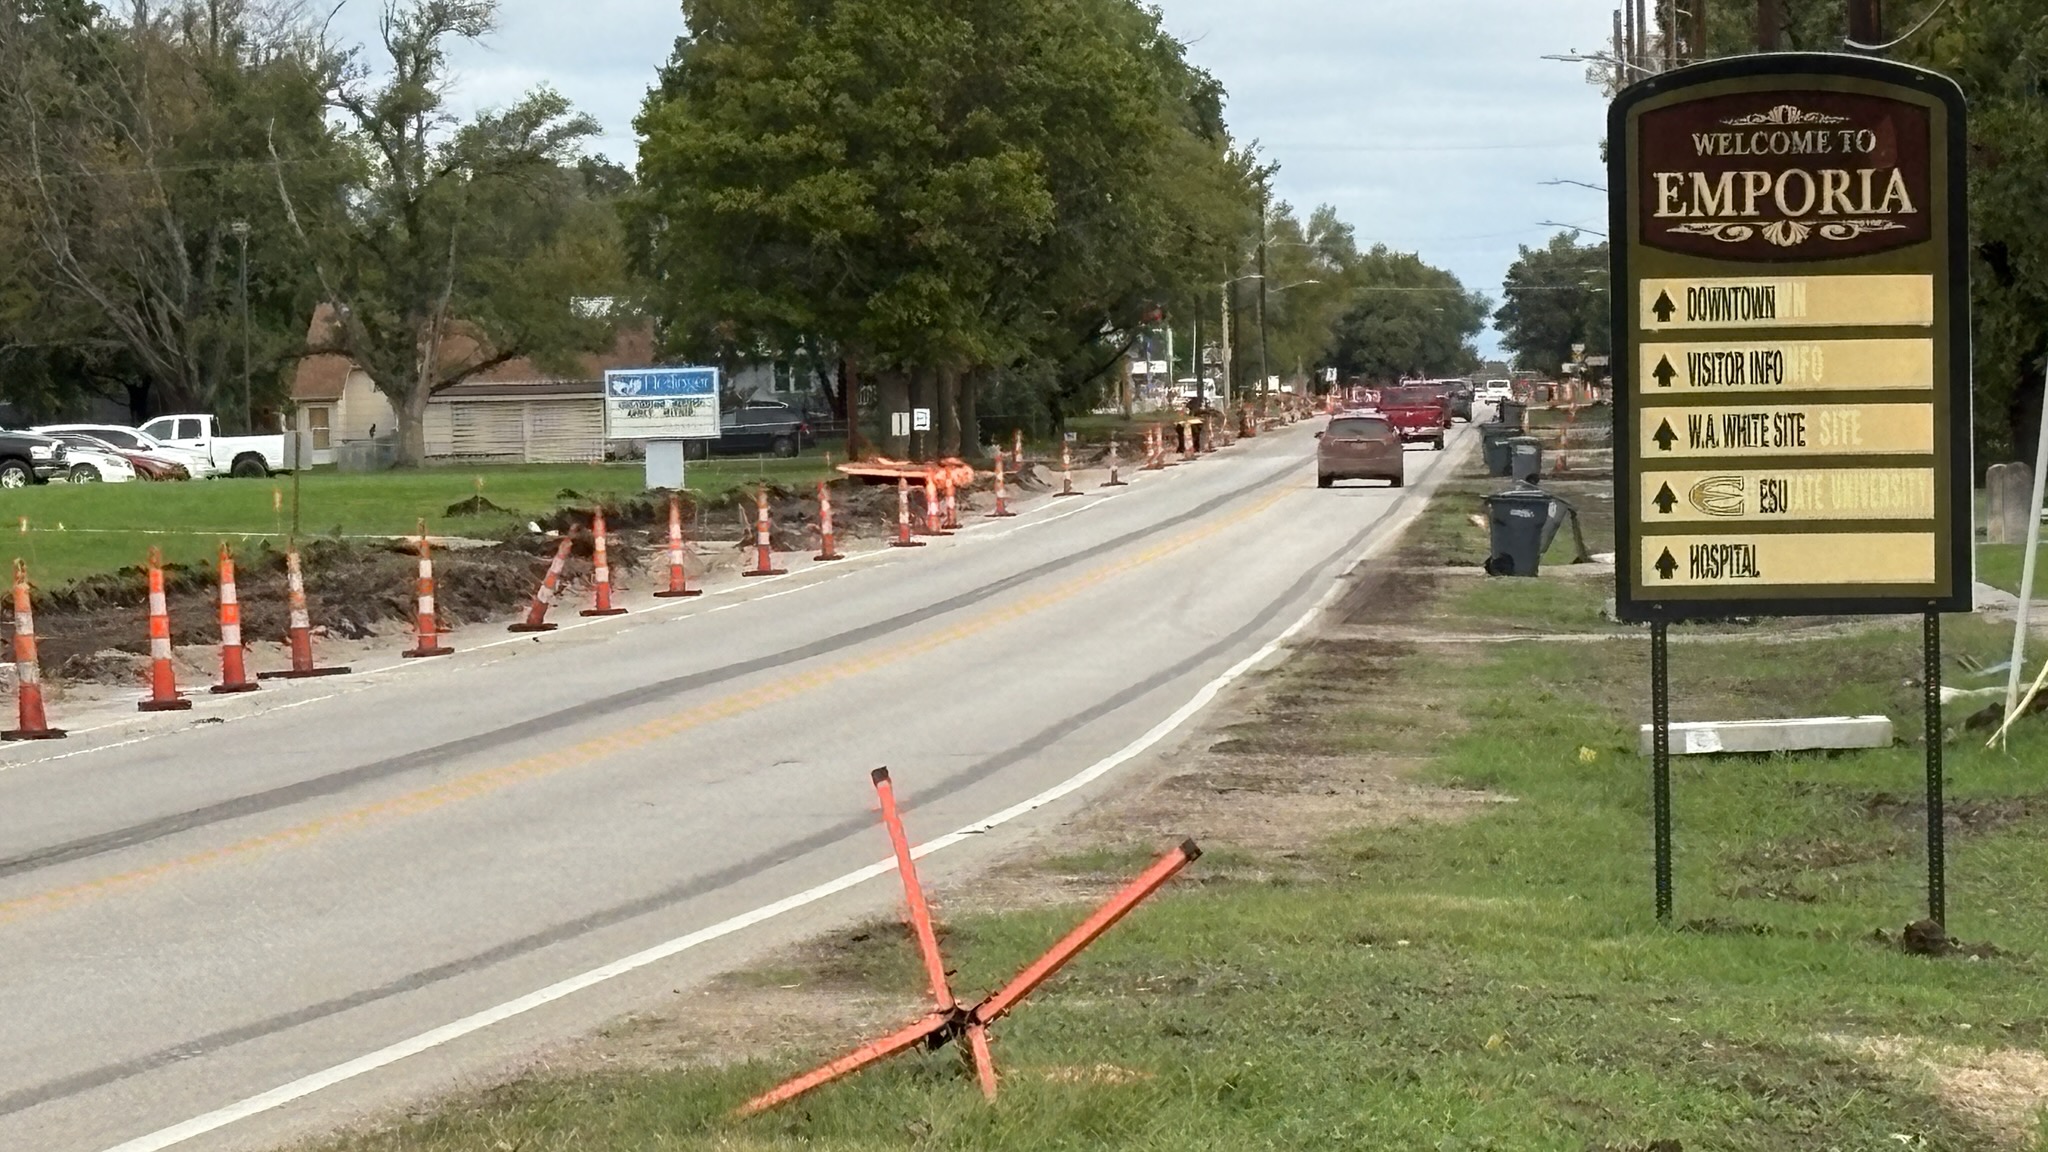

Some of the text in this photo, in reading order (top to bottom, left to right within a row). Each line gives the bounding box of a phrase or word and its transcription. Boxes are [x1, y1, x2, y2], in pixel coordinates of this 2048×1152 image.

[1692, 129, 1876, 156] WELCOME TO
[1653, 167, 1918, 218] EMPORIA
[1687, 285, 1776, 321] DOWNTOWN
[1687, 349, 1783, 386] VISITOR INFO
[1688, 412, 1806, 449] W.A. WHITE SITE
[1759, 479, 1789, 513] ESU
[1689, 543, 1761, 580] HOSPITAL
